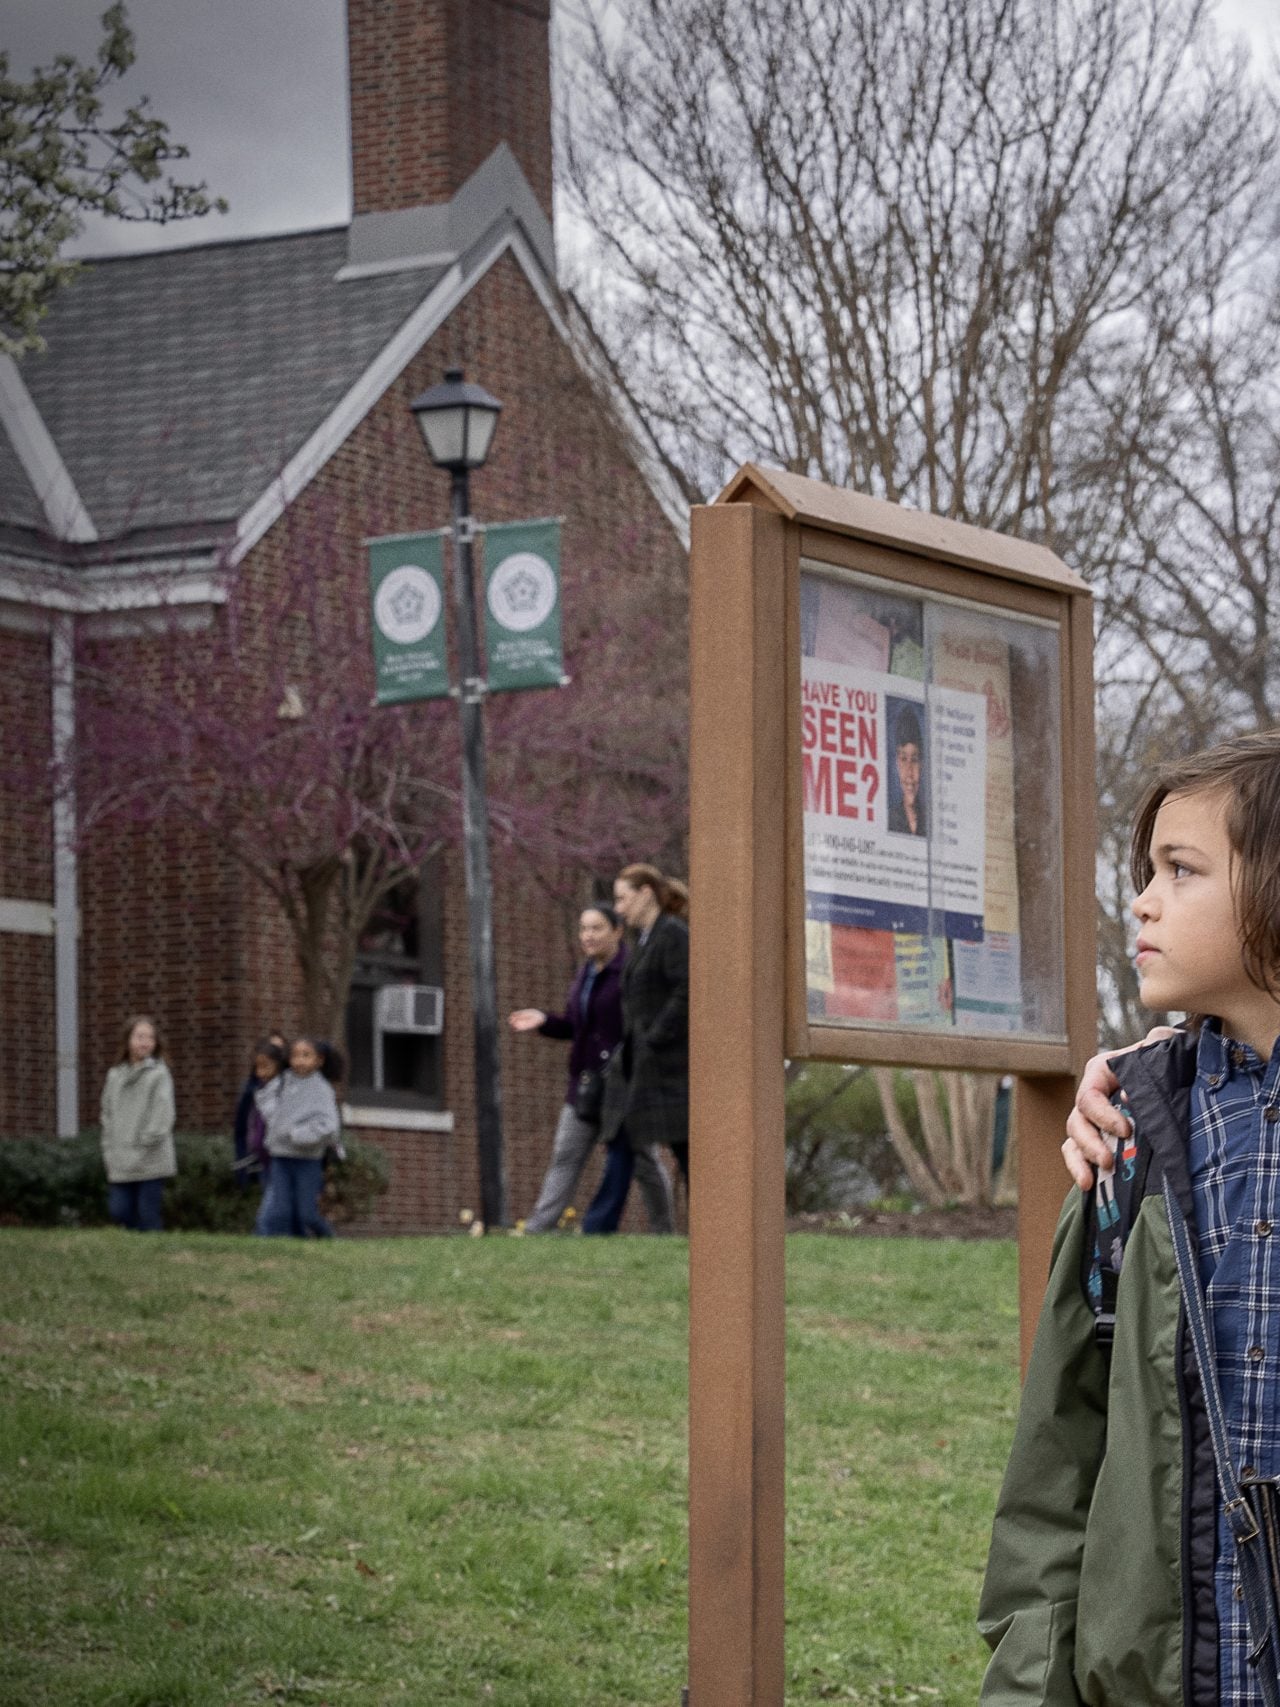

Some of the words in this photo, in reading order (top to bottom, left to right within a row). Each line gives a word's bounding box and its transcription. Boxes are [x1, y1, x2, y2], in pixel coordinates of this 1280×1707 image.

[802, 680, 841, 707] HAVE
[845, 688, 878, 714] YOU
[802, 705, 877, 761] SEEN
[803, 753, 880, 822] ME?
